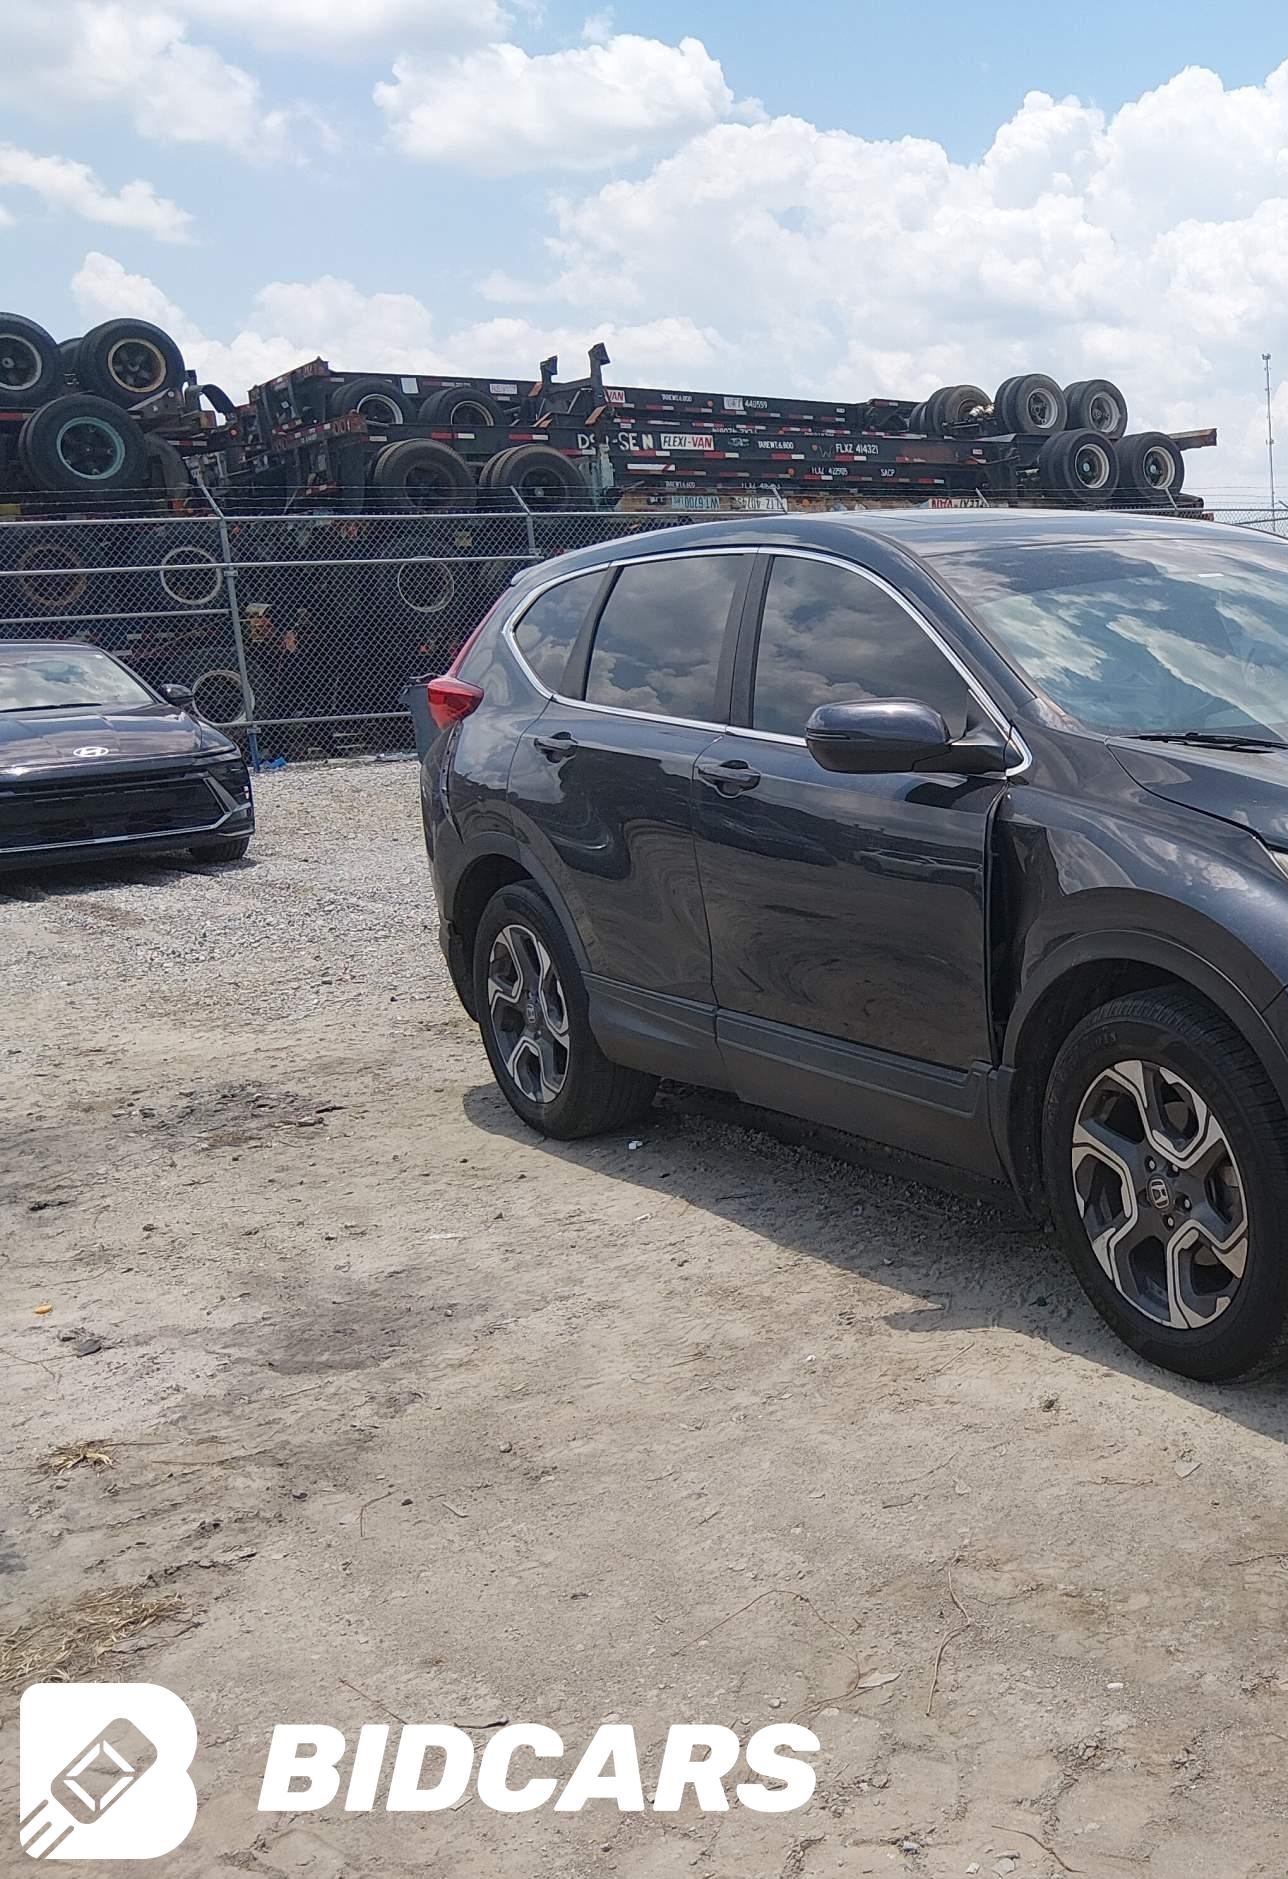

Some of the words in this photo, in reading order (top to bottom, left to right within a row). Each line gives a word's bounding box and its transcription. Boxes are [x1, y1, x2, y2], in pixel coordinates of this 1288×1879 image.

[663, 435, 712, 449] FLEXI-VAN
[835, 444, 854, 453] FLXZ
[855, 445, 879, 454] 414321
